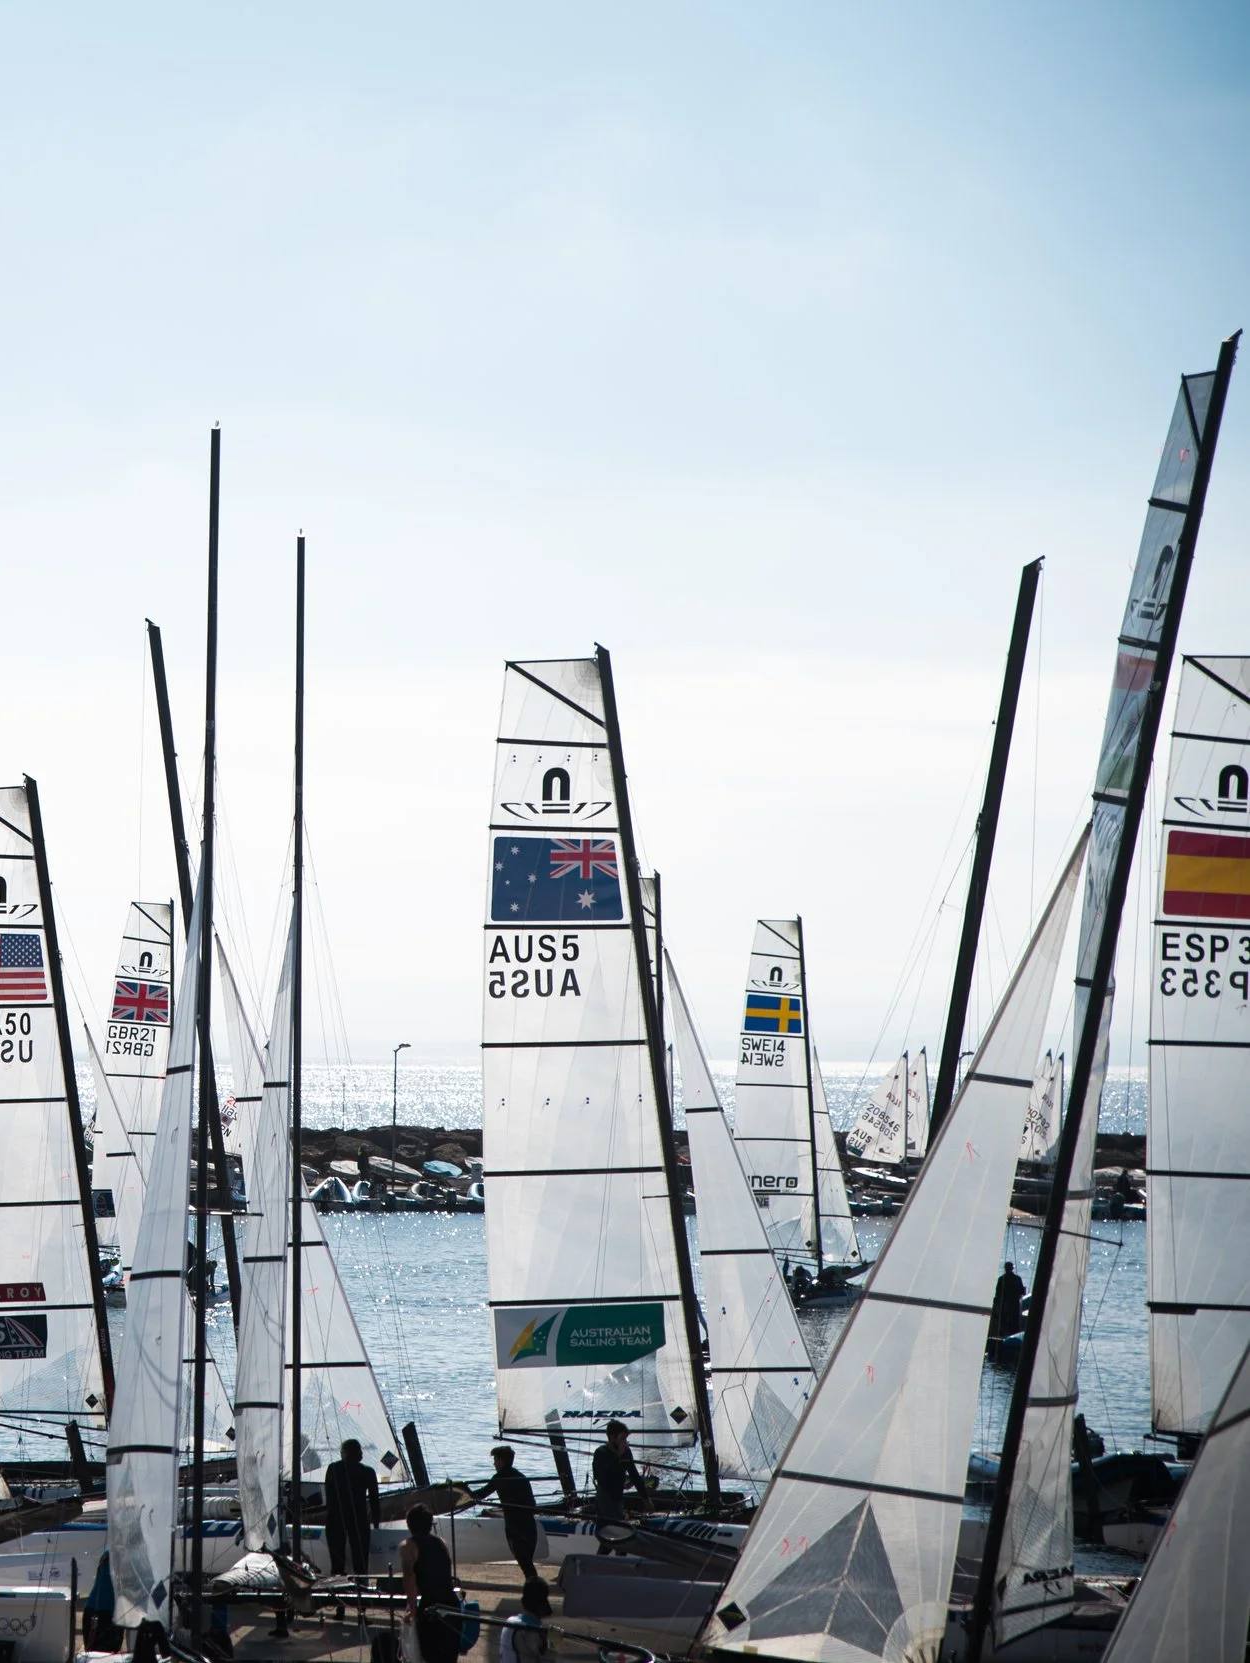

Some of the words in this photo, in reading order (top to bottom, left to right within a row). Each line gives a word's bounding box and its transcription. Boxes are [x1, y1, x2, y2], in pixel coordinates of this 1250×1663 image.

[489, 935, 579, 963] AUS5
[108, 1026, 156, 1042] GBR21
[742, 1038, 785, 1052] SWE14
[867, 1104, 900, 1132] 208546
[853, 1129, 872, 1143] AUS
[570, 1326, 650, 1338] AUSTRALIAN
[570, 1337, 616, 1347] SAILING
[619, 1336, 651, 1346] TEAM
[15, 1349, 43, 1358] TEAM
